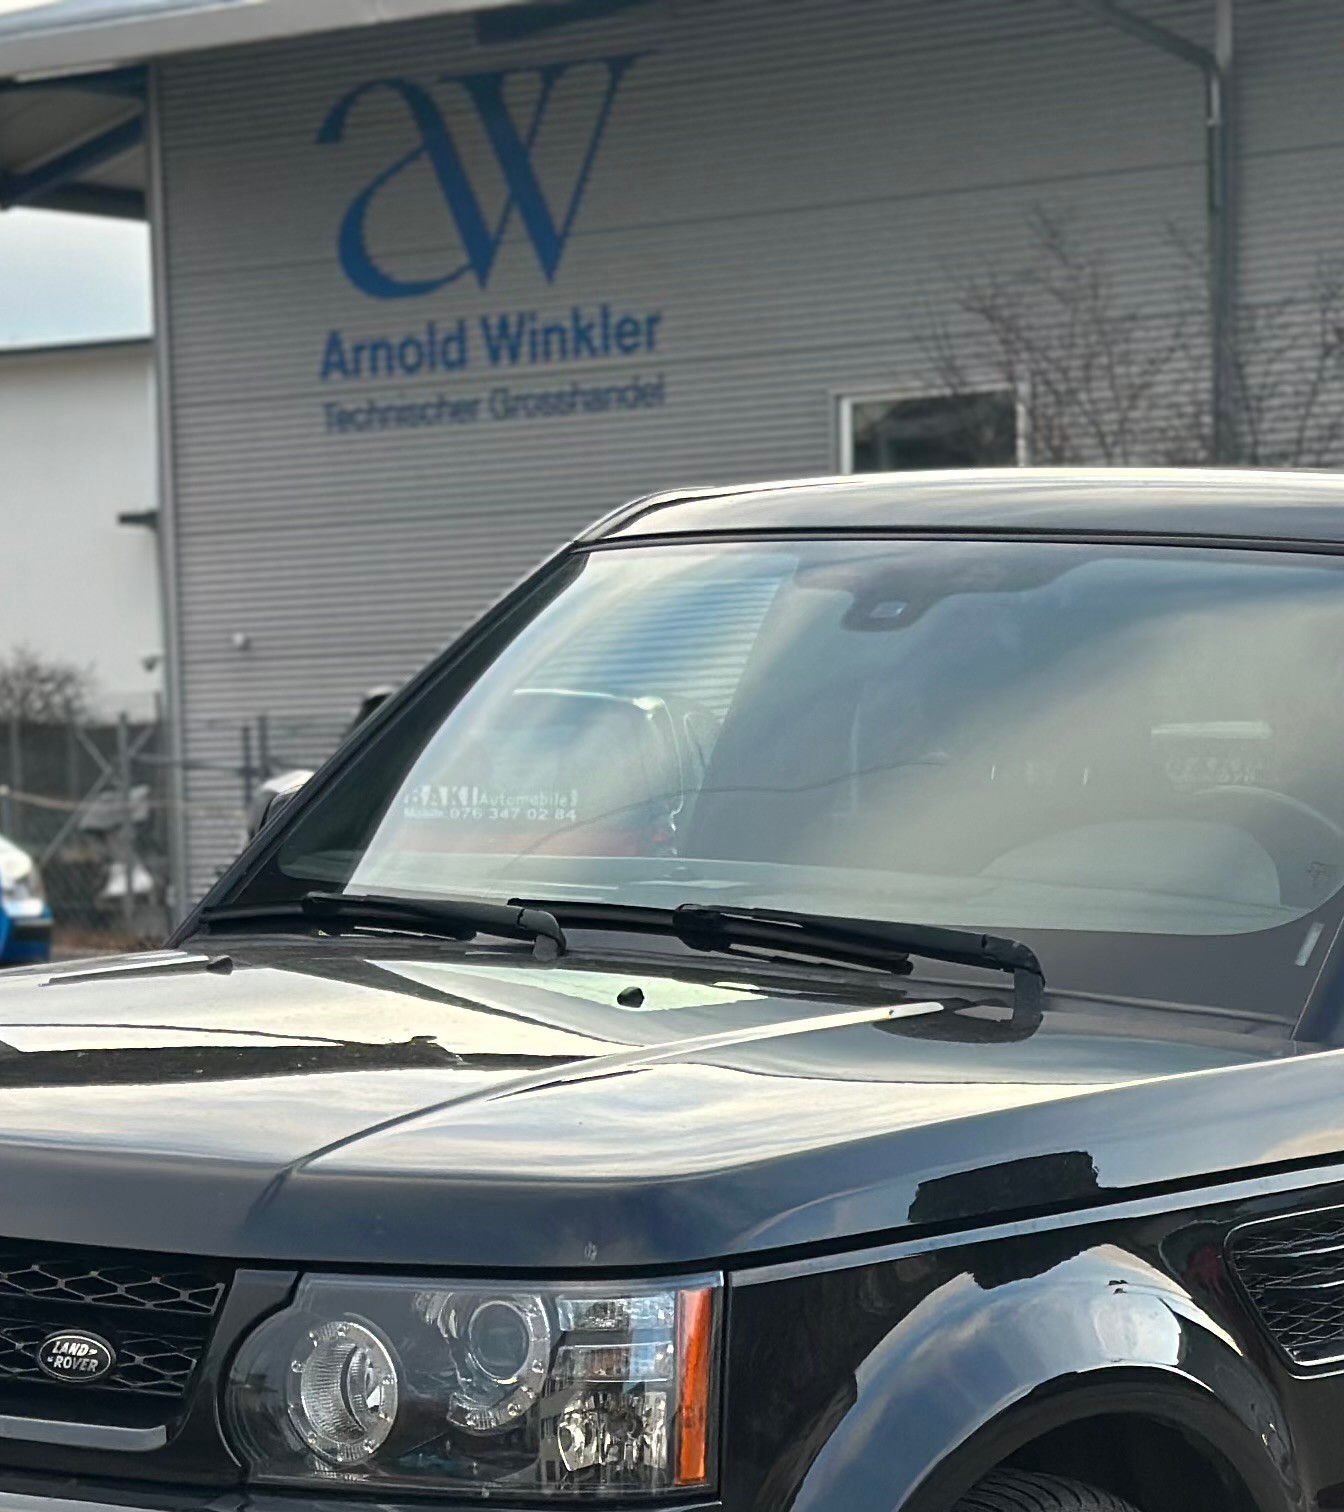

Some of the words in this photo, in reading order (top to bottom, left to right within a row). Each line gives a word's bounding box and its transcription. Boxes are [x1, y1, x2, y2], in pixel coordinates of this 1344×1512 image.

[320, 318, 467, 380] Arnold
[481, 303, 662, 366] Winkler
[322, 394, 481, 434] Technischer
[489, 372, 666, 421] Grosshandel
[478, 792, 568, 807] Automobile
[449, 808, 483, 820] 076
[488, 808, 521, 820] 347
[527, 808, 549, 820] 02
[554, 808, 578, 821] 84
[52, 1341, 90, 1356] LAND
[53, 1355, 99, 1372] ROVER
